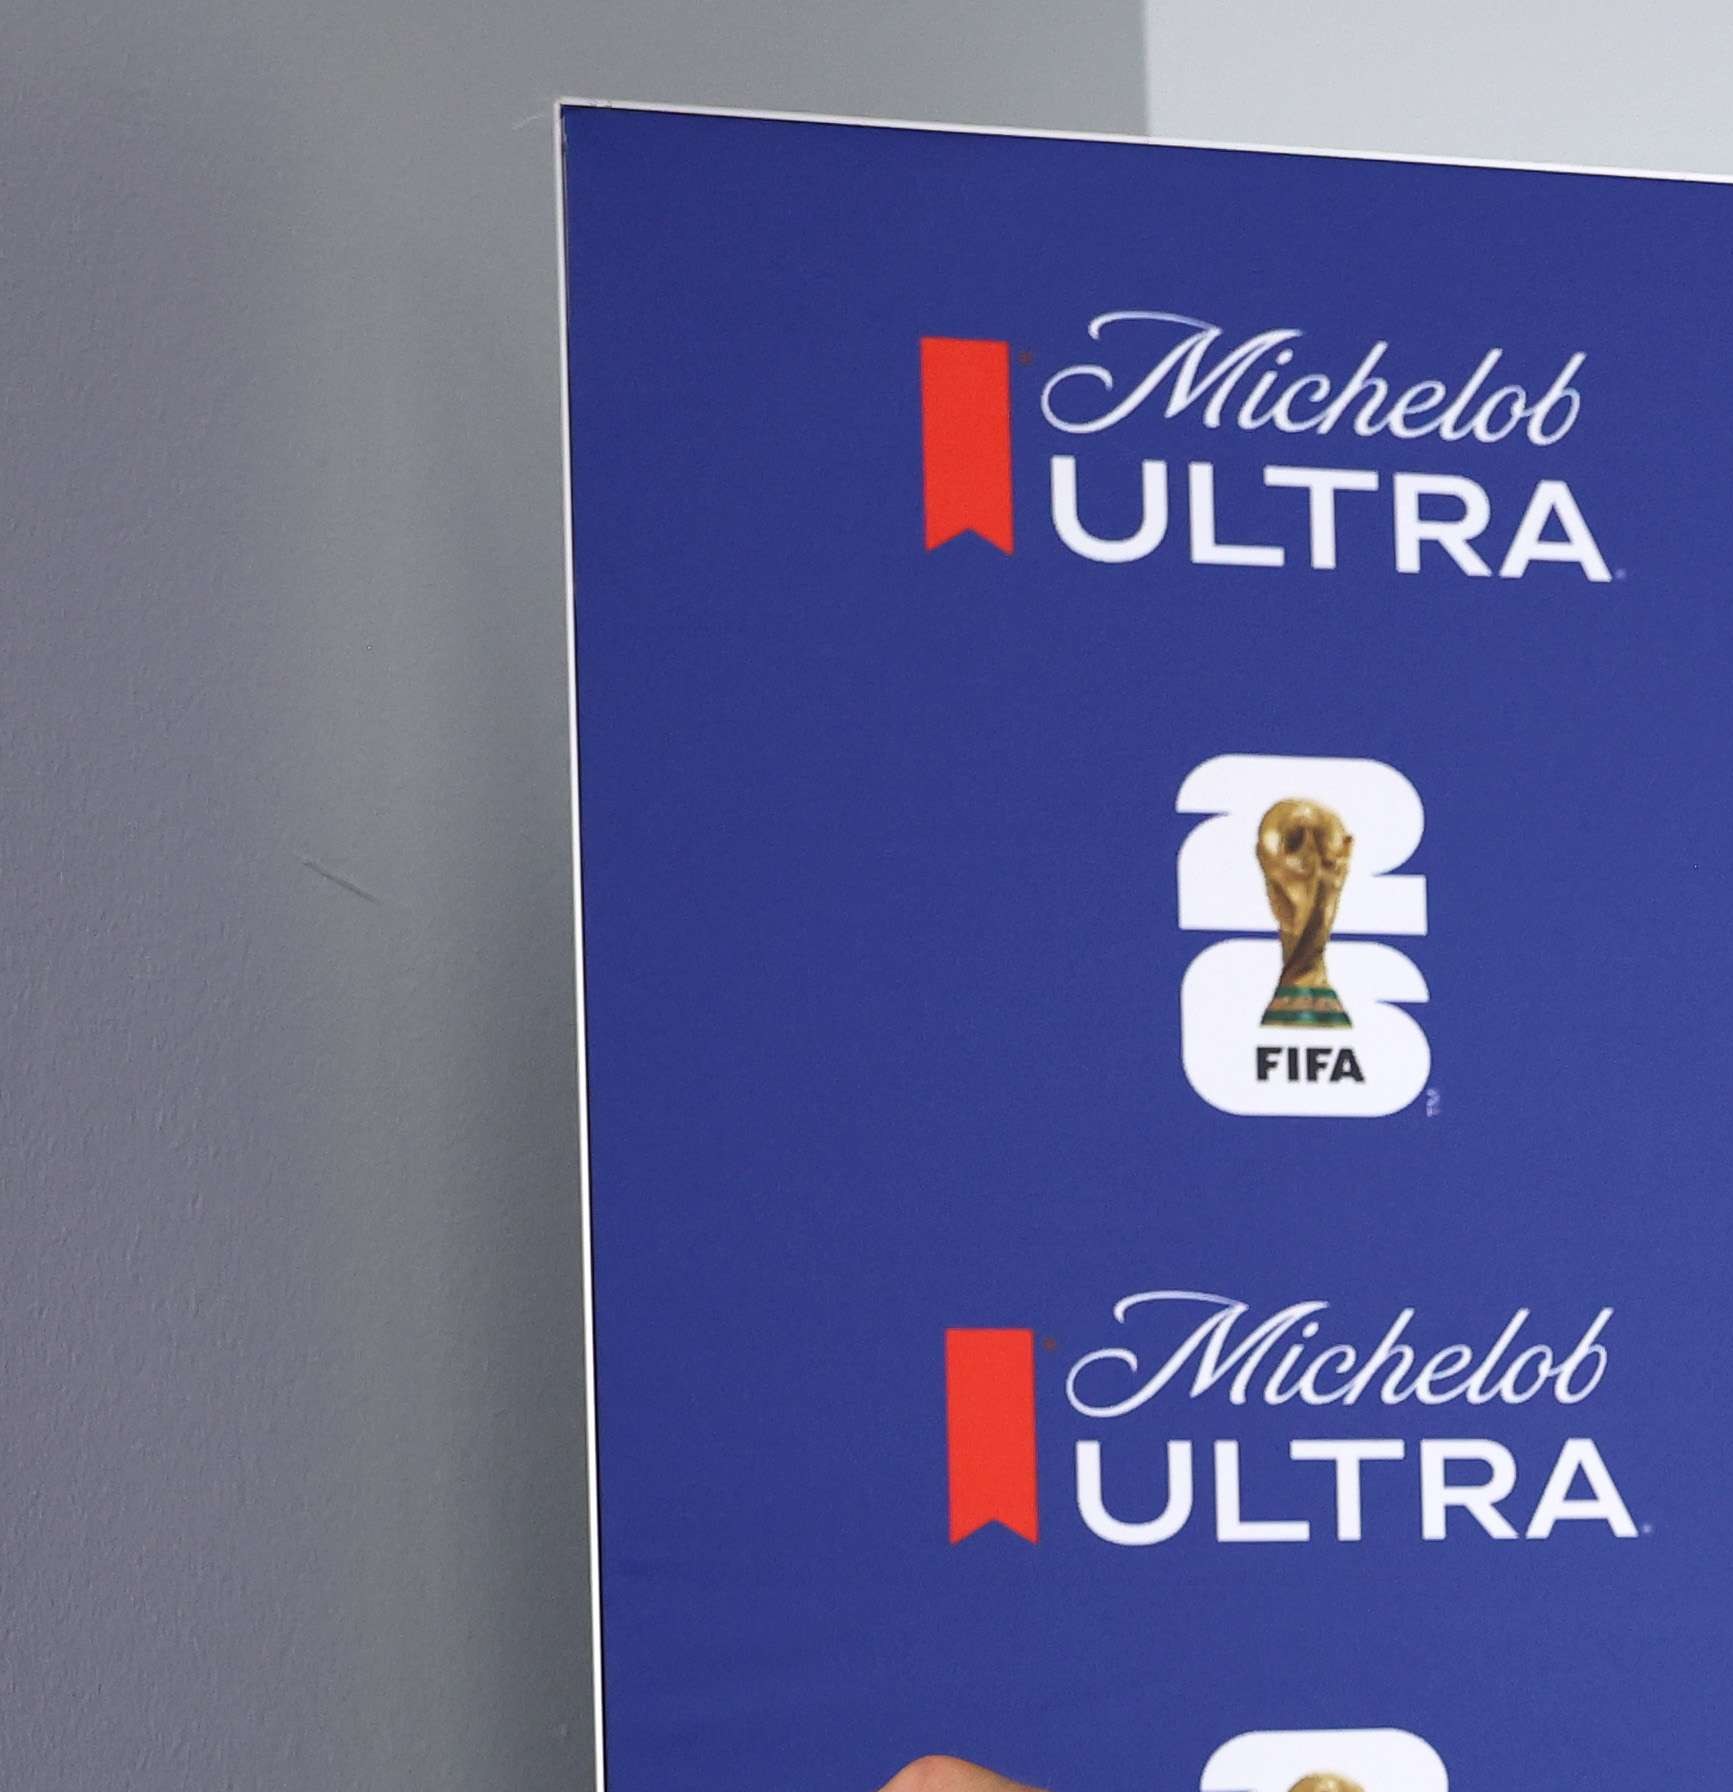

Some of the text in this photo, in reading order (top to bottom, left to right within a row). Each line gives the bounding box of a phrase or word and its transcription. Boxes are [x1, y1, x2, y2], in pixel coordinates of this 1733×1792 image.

[1042, 312, 1585, 445] Michelob
[1051, 456, 1611, 582] ULTRA
[1257, 1047, 1365, 1083] FIFA
[1067, 1291, 1613, 1417] Michelob
[1077, 1439, 1637, 1545] ULTRA
